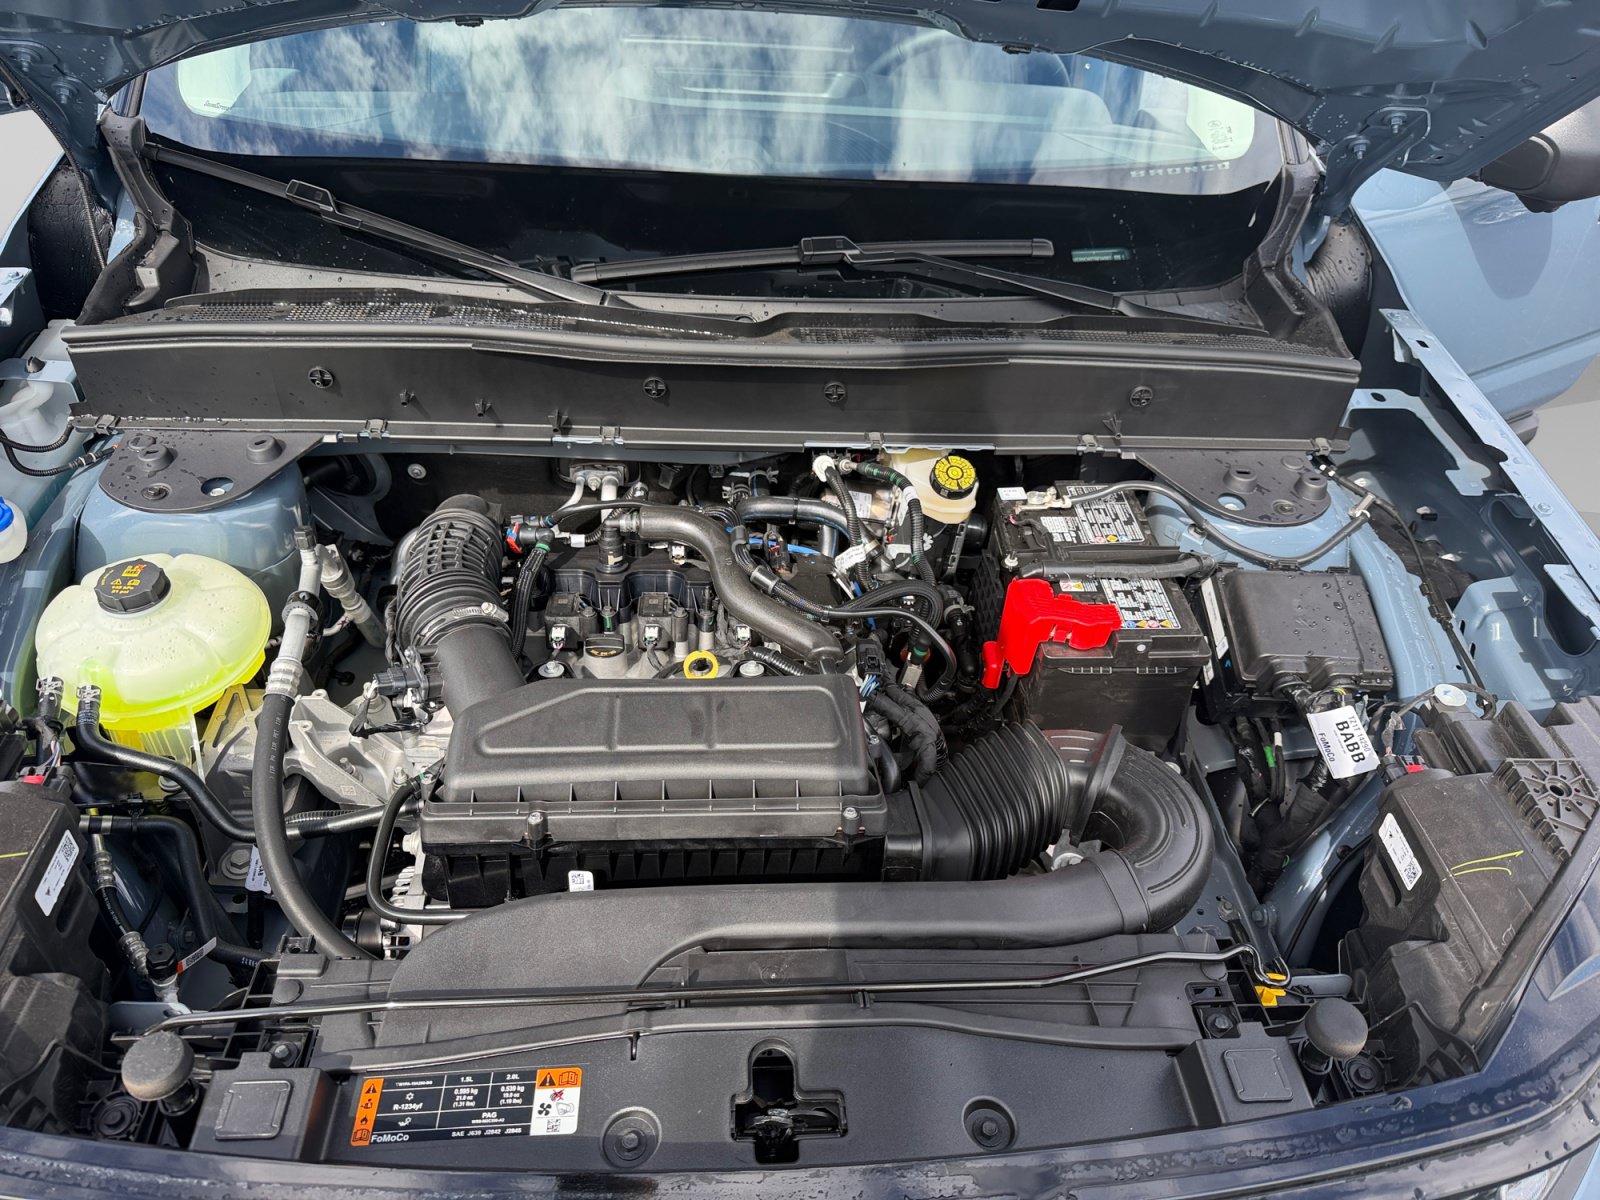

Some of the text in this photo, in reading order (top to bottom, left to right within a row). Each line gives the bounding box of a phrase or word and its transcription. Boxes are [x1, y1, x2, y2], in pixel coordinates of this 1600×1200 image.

[1129, 161, 1231, 178] BRONCO
[1318, 732, 1336, 762] FoMoCo
[1335, 720, 1366, 763] BABB
[470, 1088, 479, 1096] kg
[392, 1102, 423, 1111] R-1234yf
[371, 1133, 410, 1143] FoMoCo
